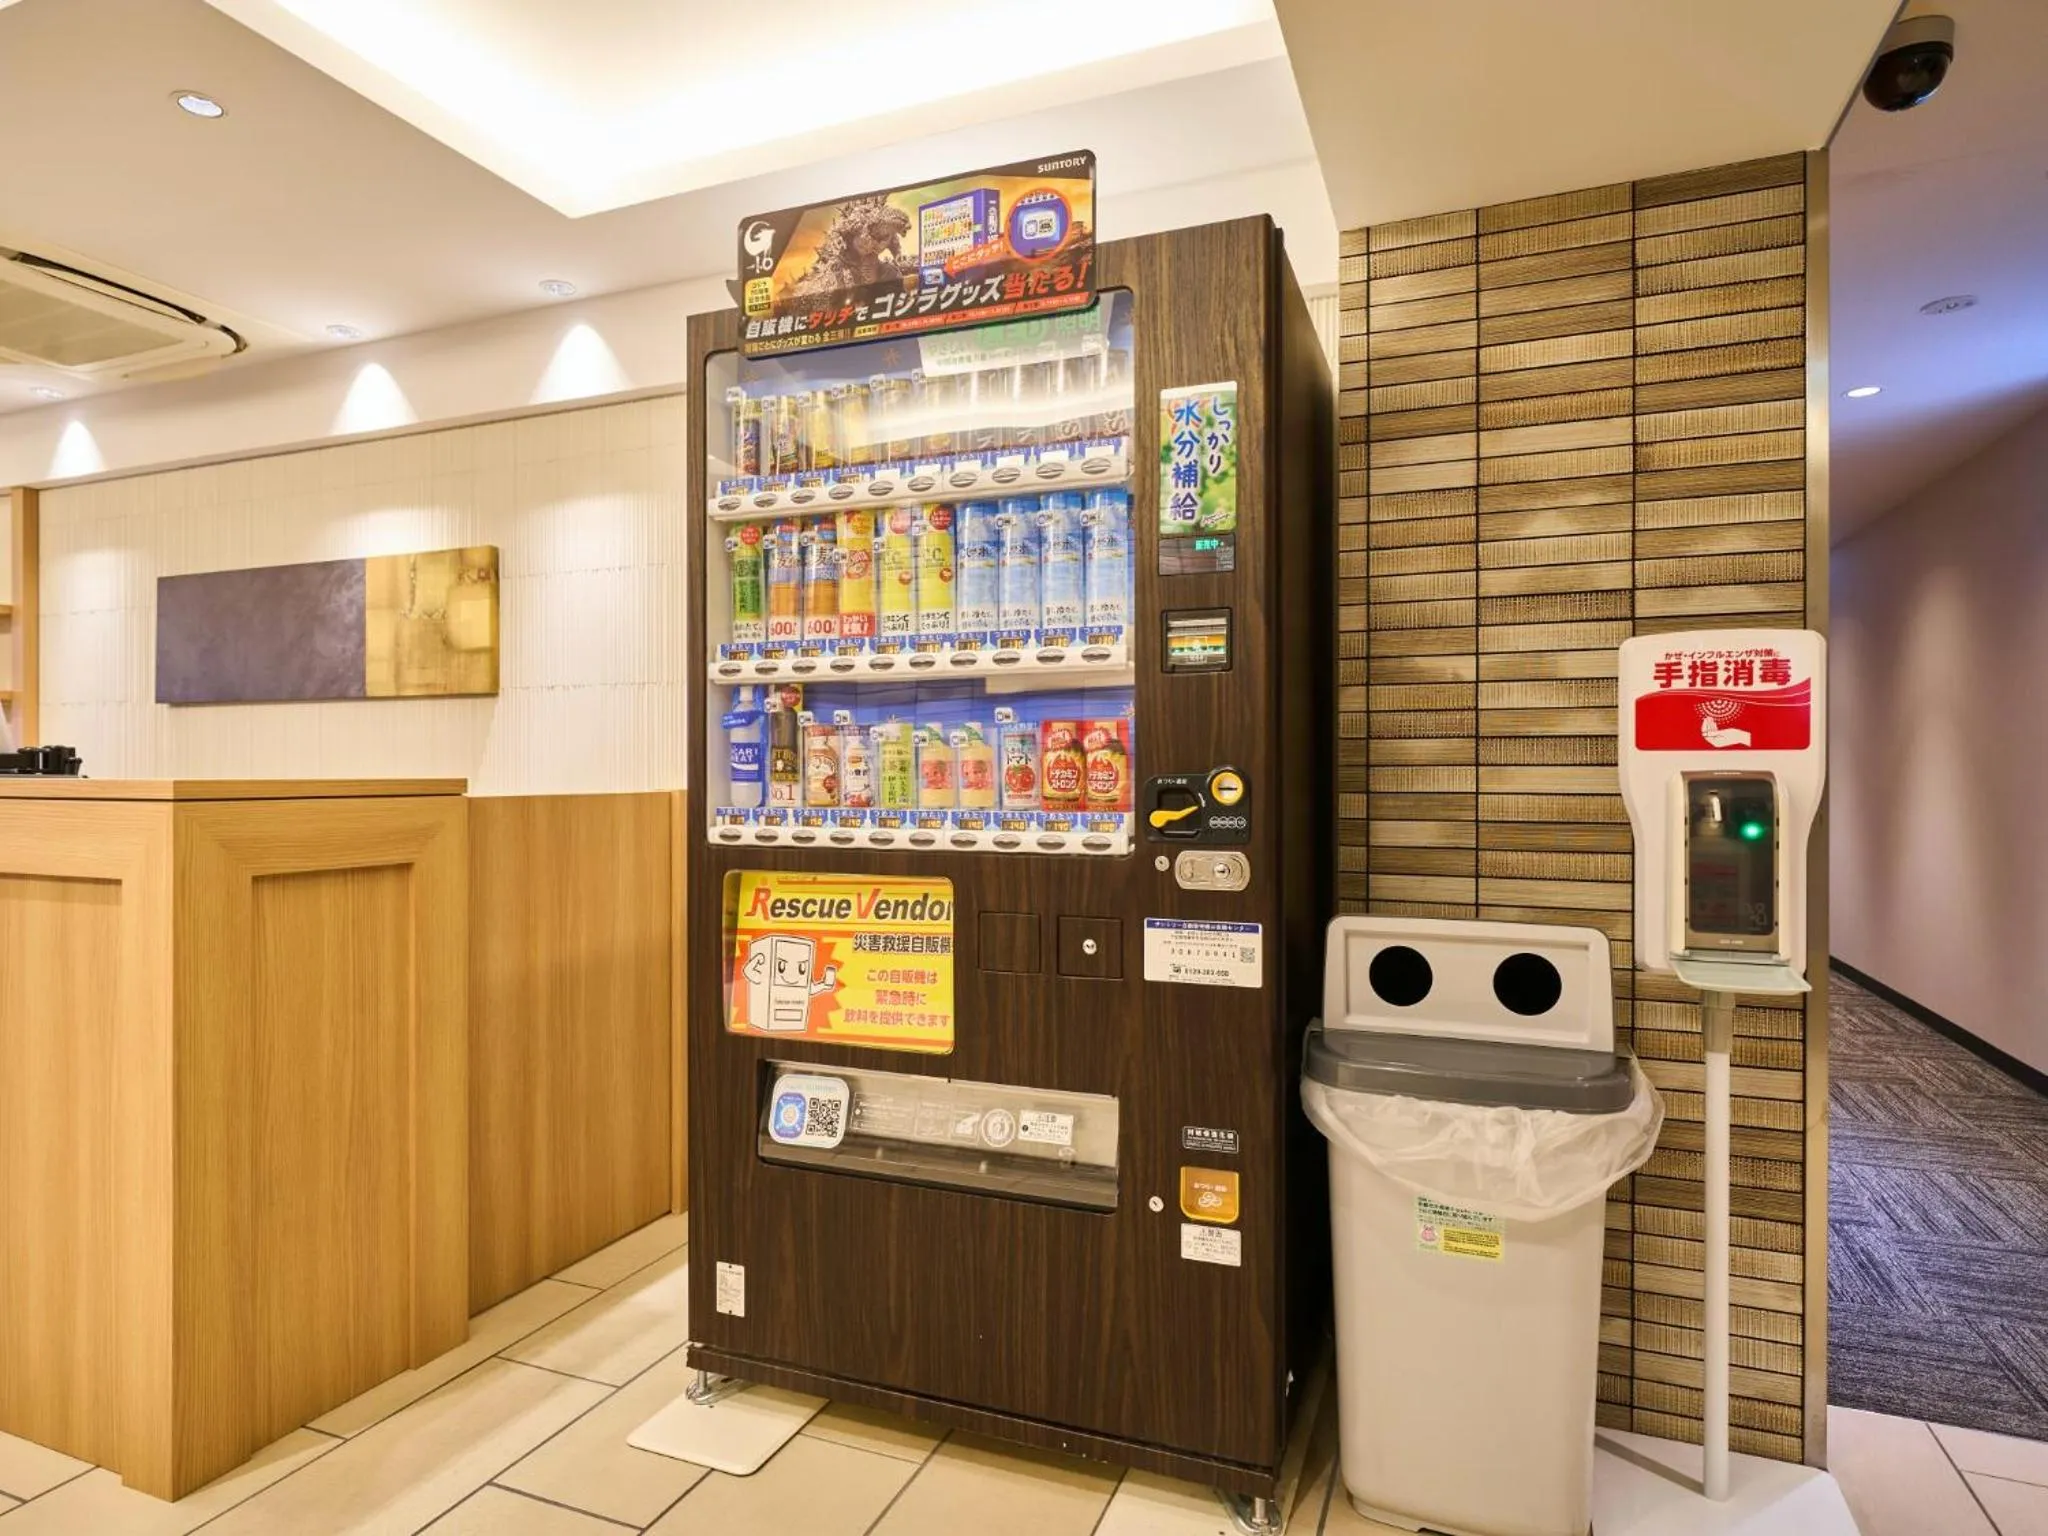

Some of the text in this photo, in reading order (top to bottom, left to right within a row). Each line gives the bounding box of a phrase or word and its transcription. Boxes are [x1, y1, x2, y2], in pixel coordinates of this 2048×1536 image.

[1037, 155, 1087, 174] SUNTORY
[1207, 396, 1231, 474] しっかり
[1171, 399, 1202, 521] 水分補給
[1664, 647, 1780, 661] かぜ・インフルエンザ対策に
[1653, 658, 1792, 689] 手指消毒
[1005, 753, 1032, 765] トマト
[744, 887, 852, 921] Rescue
[866, 968, 938, 985] この自販機は
[875, 989, 928, 1007] 緊急時に
[843, 1007, 951, 1028] 飲料を提供できます
